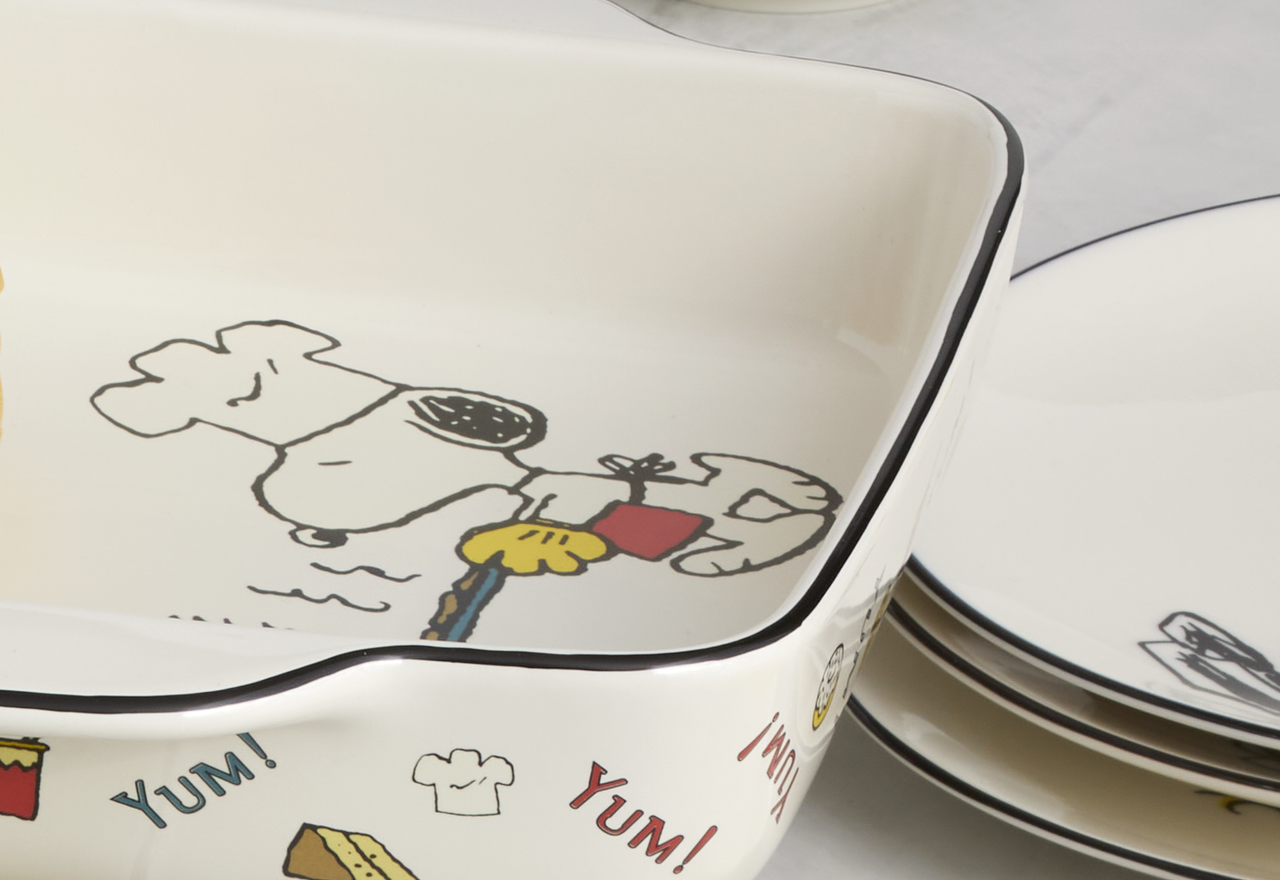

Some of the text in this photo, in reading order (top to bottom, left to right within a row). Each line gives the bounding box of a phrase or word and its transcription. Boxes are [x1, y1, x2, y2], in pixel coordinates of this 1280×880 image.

[110, 732, 277, 829] YUM!
[569, 761, 718, 874] YUM!
[737, 711, 799, 824] YUM!
